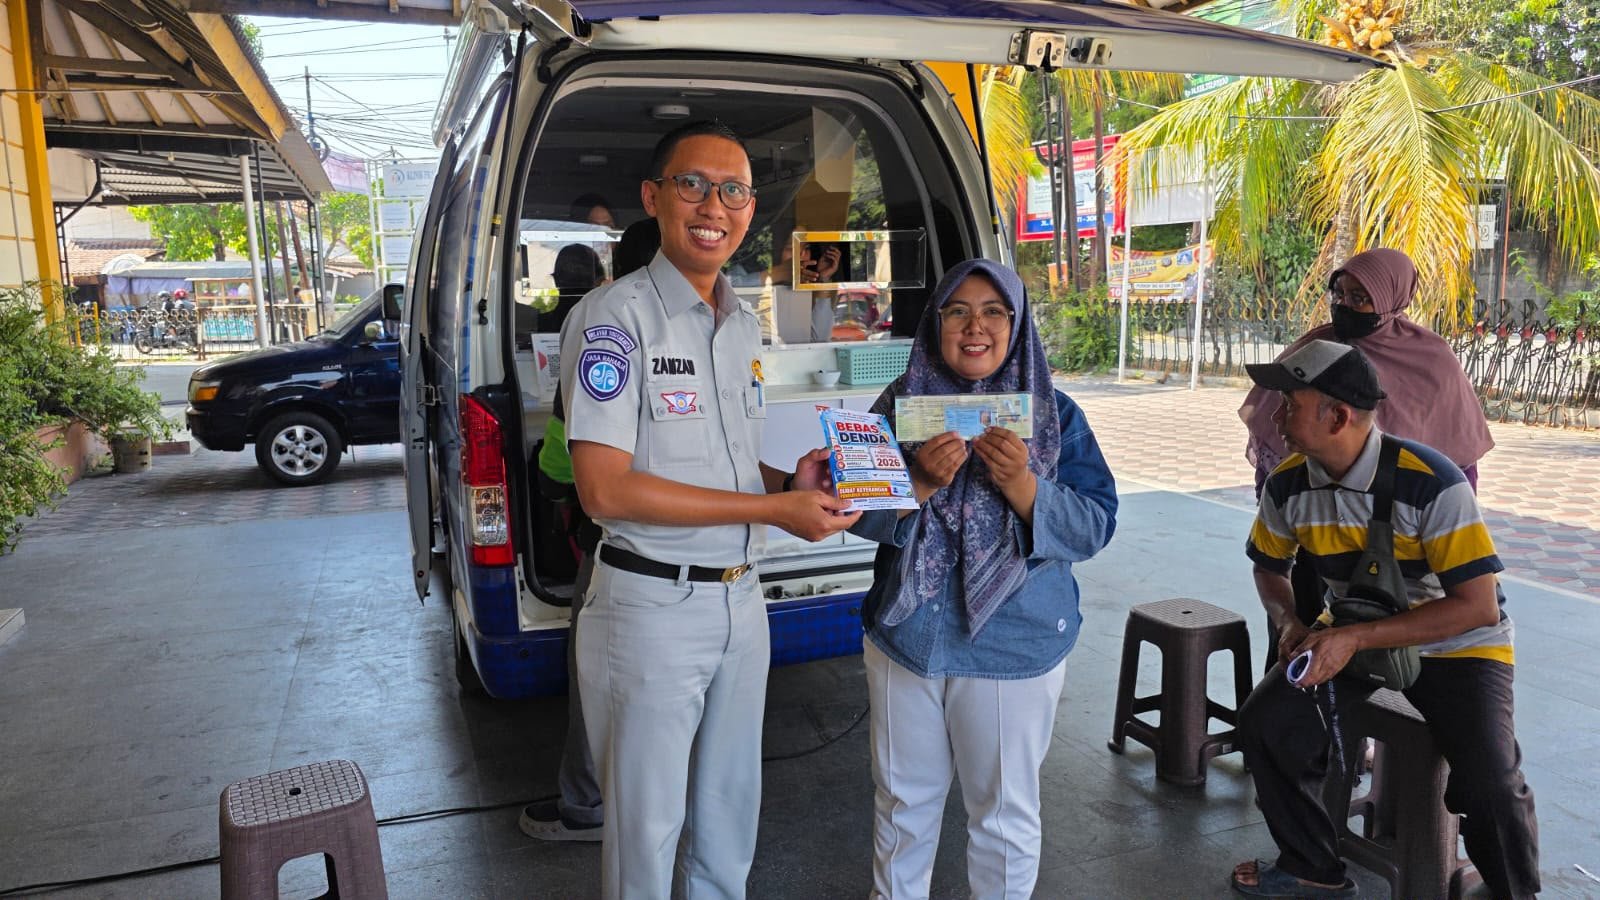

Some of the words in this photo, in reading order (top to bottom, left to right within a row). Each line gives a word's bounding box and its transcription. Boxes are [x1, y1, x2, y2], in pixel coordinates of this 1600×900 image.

[586, 354, 601, 362] JASA
[602, 355, 626, 371] RAHARJA
[836, 421, 879, 433] BEBAS
[839, 432, 889, 444] DENDA
[877, 458, 901, 467] 2026
